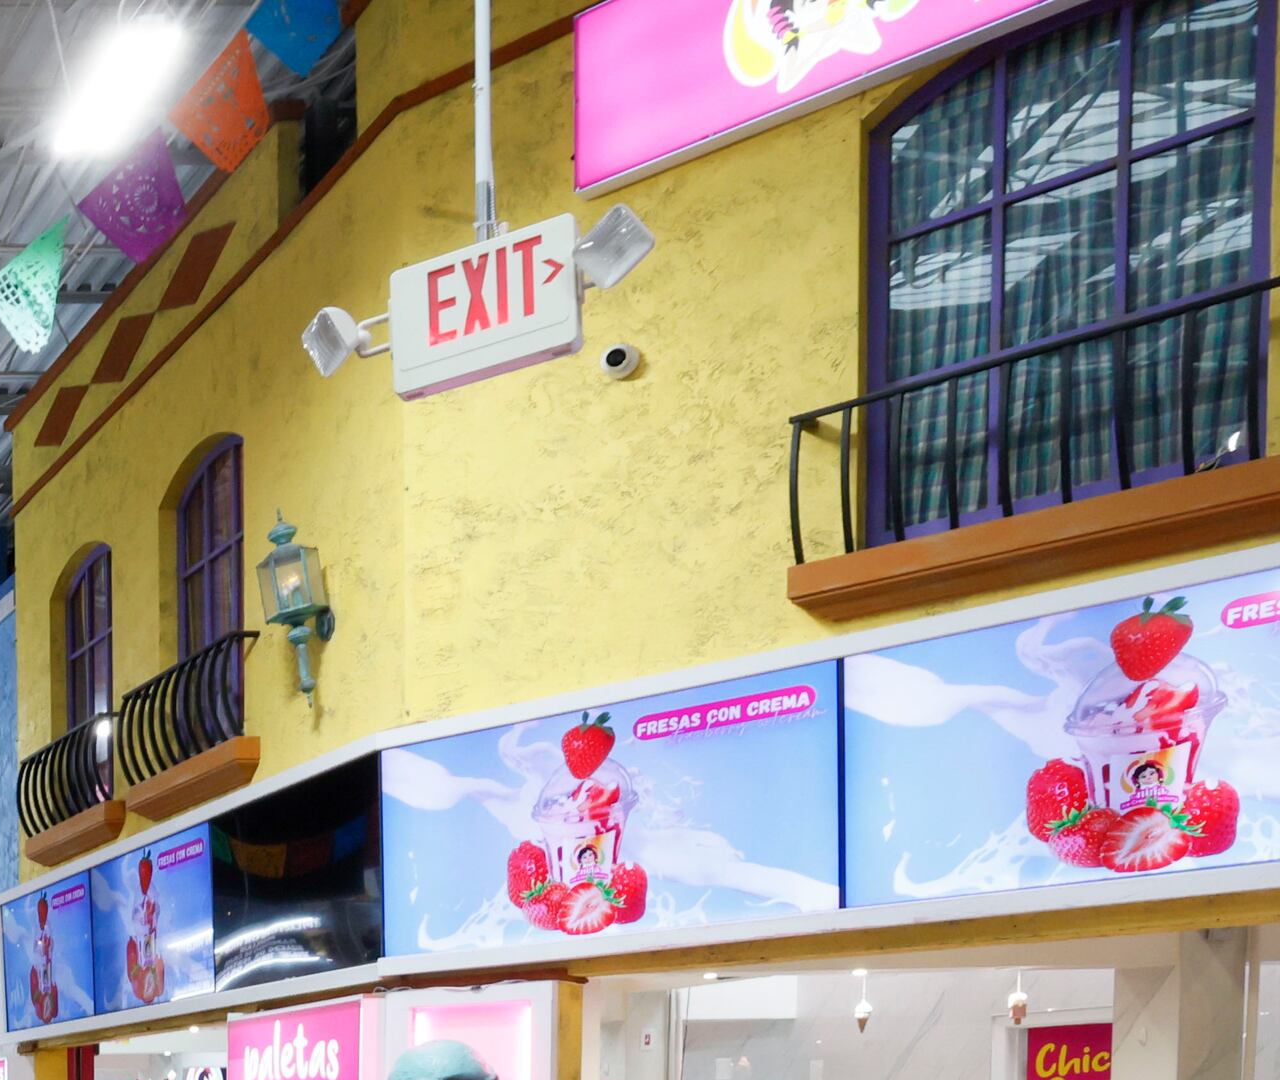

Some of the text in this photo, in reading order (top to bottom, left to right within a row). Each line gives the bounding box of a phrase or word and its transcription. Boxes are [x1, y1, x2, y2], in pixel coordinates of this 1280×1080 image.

[427, 235, 543, 347] EXIT
[1226, 599, 1280, 626] FRE
[636, 691, 811, 738] FRESAS CON CREMA
[1035, 1042, 1111, 1078] Chic
